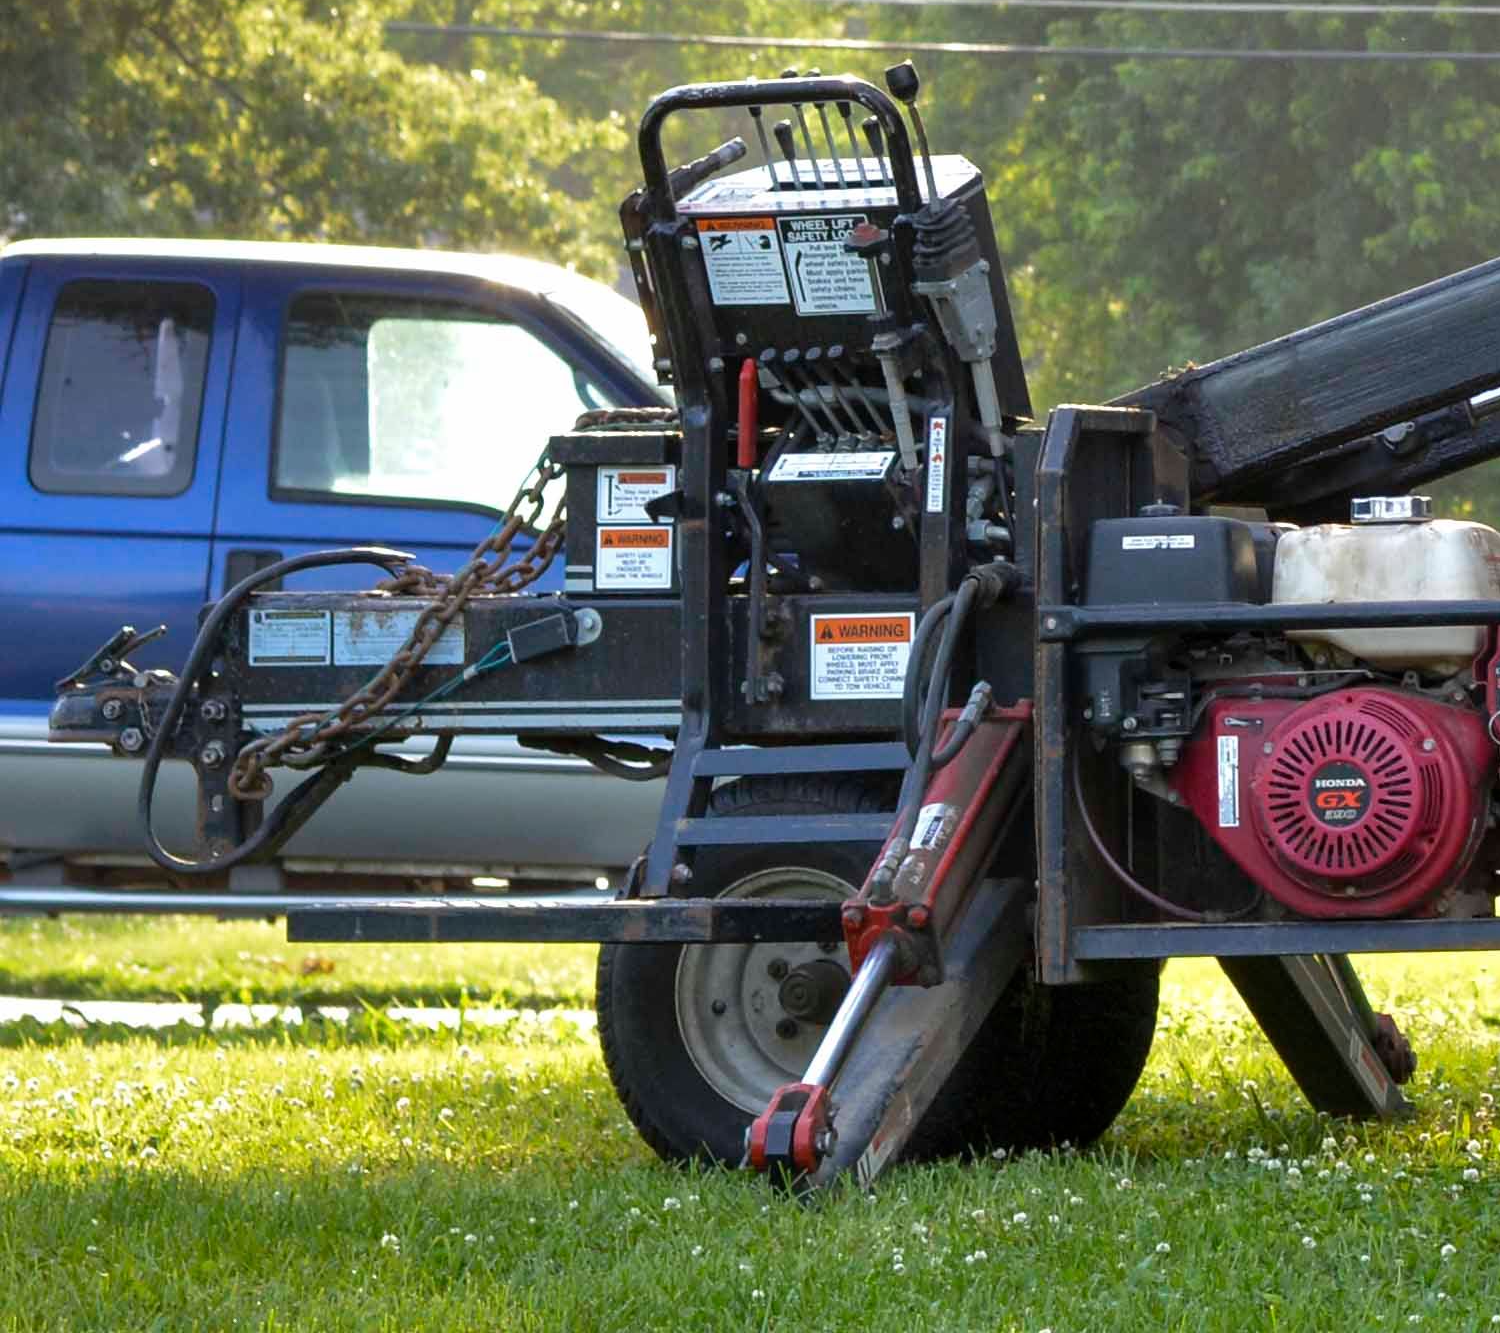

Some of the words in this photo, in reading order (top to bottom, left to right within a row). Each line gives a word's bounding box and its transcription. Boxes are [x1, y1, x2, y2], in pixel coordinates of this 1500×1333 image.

[790, 219, 827, 231] WHEEL
[832, 218, 855, 230] LIFT
[786, 231, 830, 242] SAFETY
[832, 230, 858, 241] LOC
[618, 533, 664, 545] WARNING
[839, 623, 904, 638] WARNING
[1315, 778, 1366, 788] HONDA
[1316, 790, 1362, 809] GX
